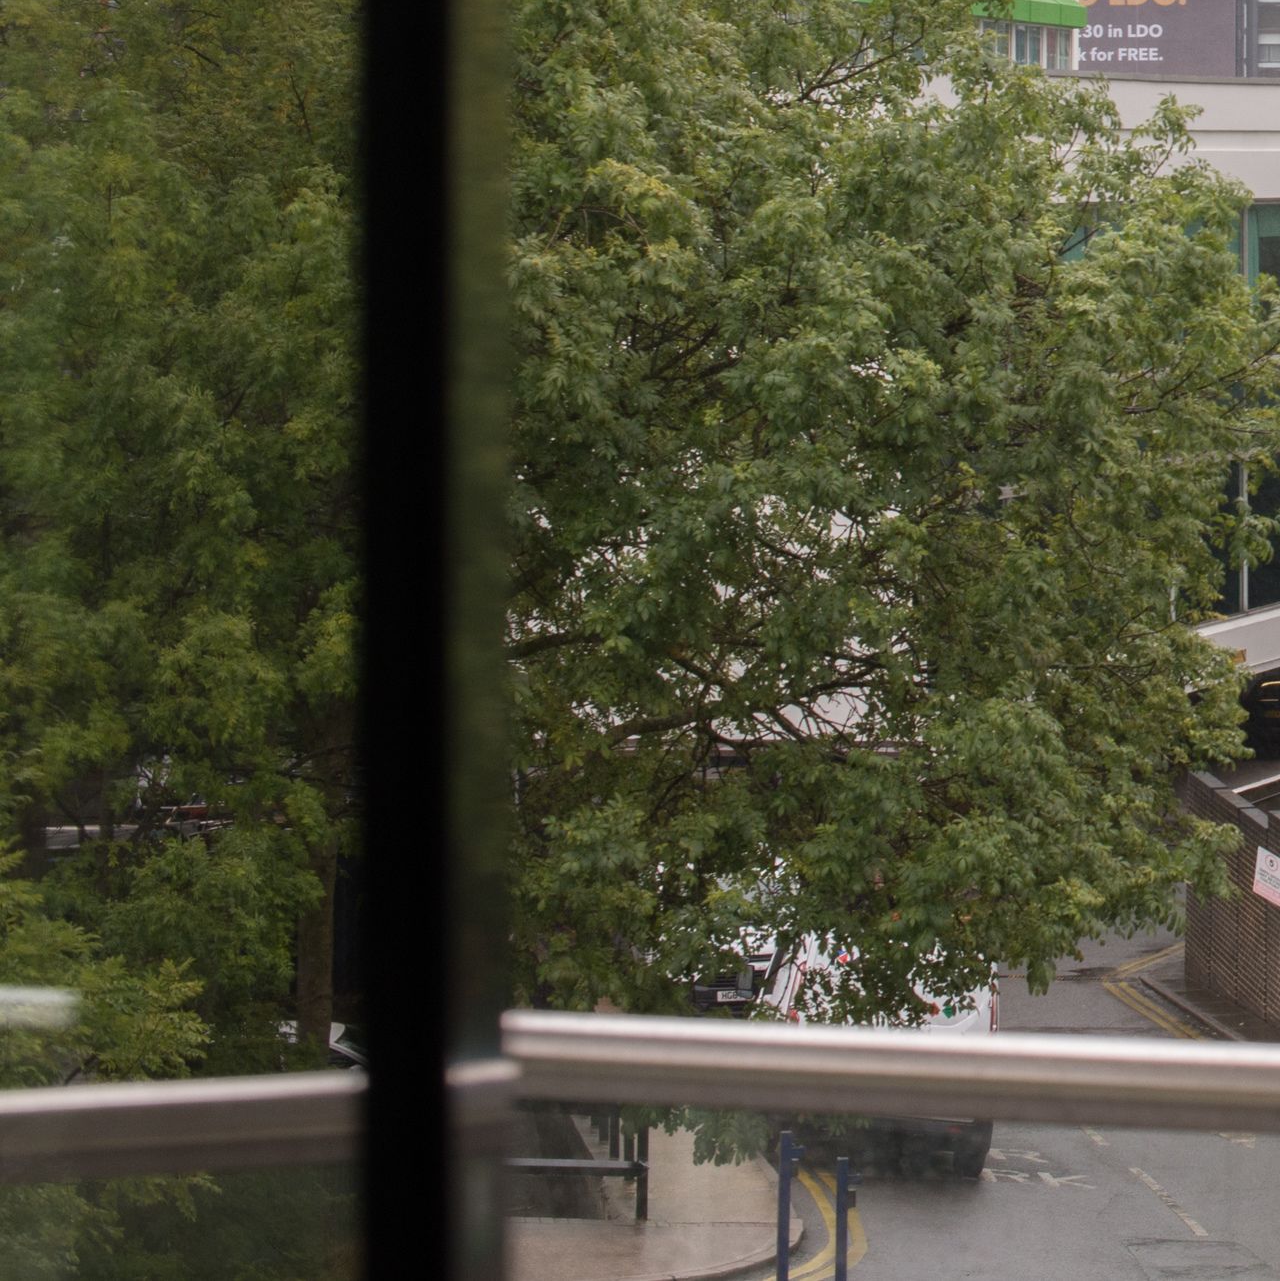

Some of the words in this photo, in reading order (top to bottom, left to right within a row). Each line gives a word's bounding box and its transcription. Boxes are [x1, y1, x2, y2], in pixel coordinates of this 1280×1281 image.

[1108, 24, 1123, 38] in
[1127, 24, 1163, 38] LDO
[1090, 47, 1114, 61] for
[1118, 48, 1163, 61] FREE.
